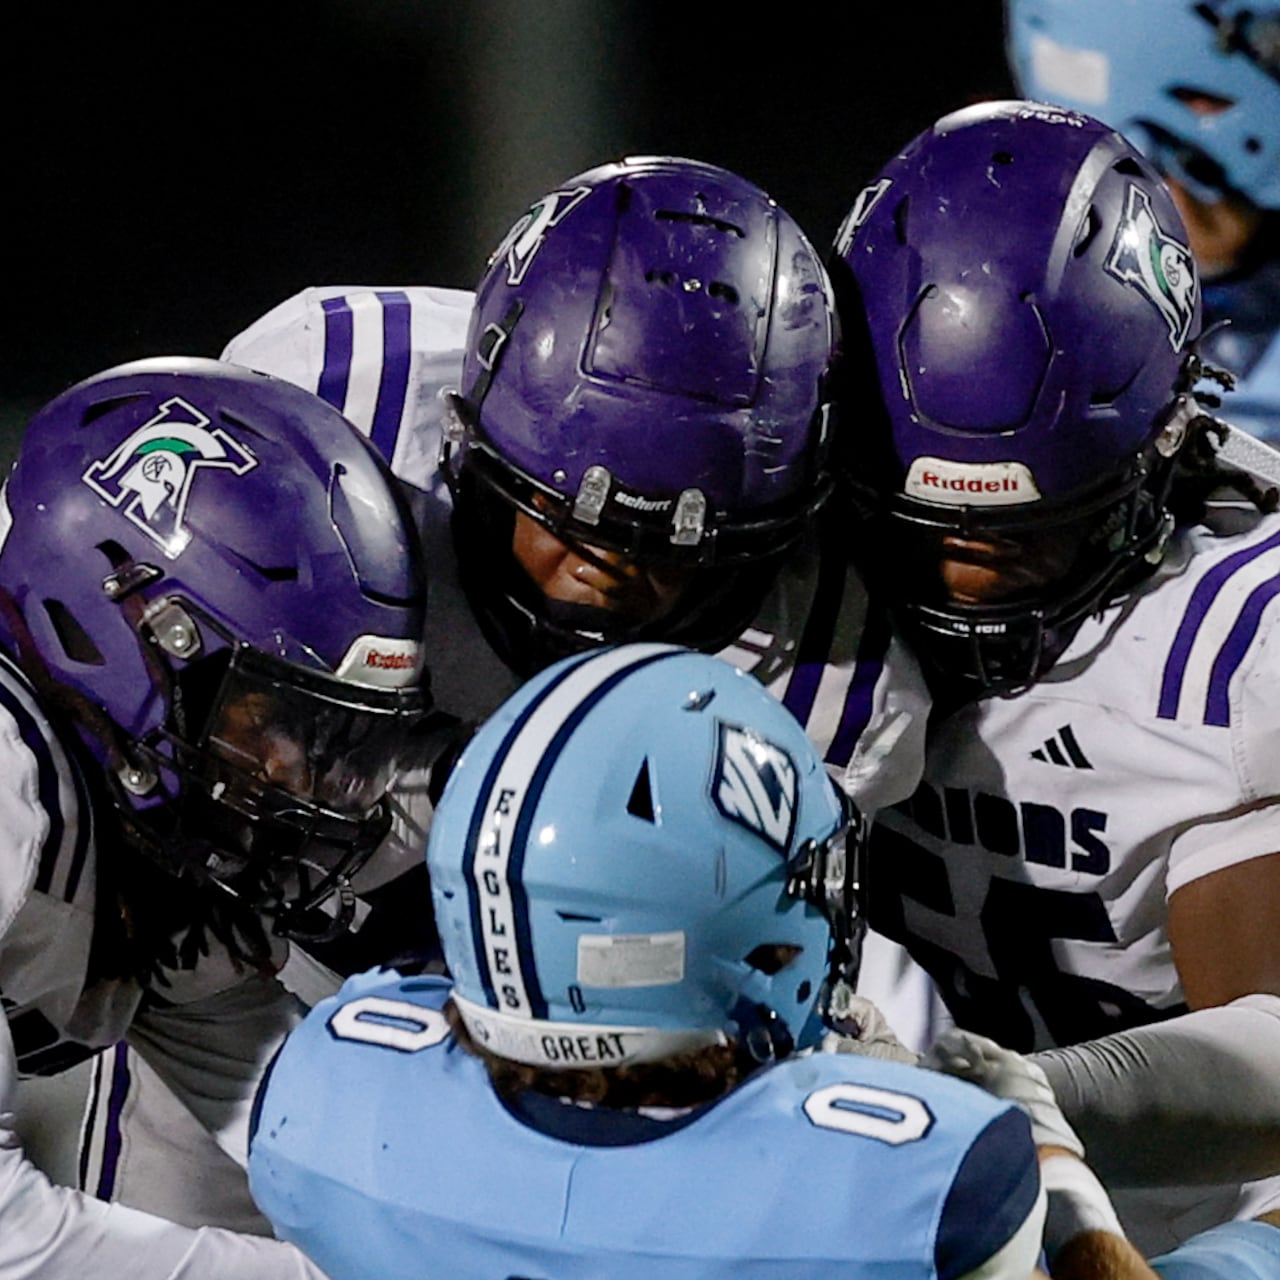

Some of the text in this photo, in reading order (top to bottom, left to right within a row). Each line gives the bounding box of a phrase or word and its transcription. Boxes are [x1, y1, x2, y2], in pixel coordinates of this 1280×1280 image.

[325, 995, 451, 1054] 0
[541, 1033, 628, 1062] GREAT
[801, 1080, 936, 1147] 0
